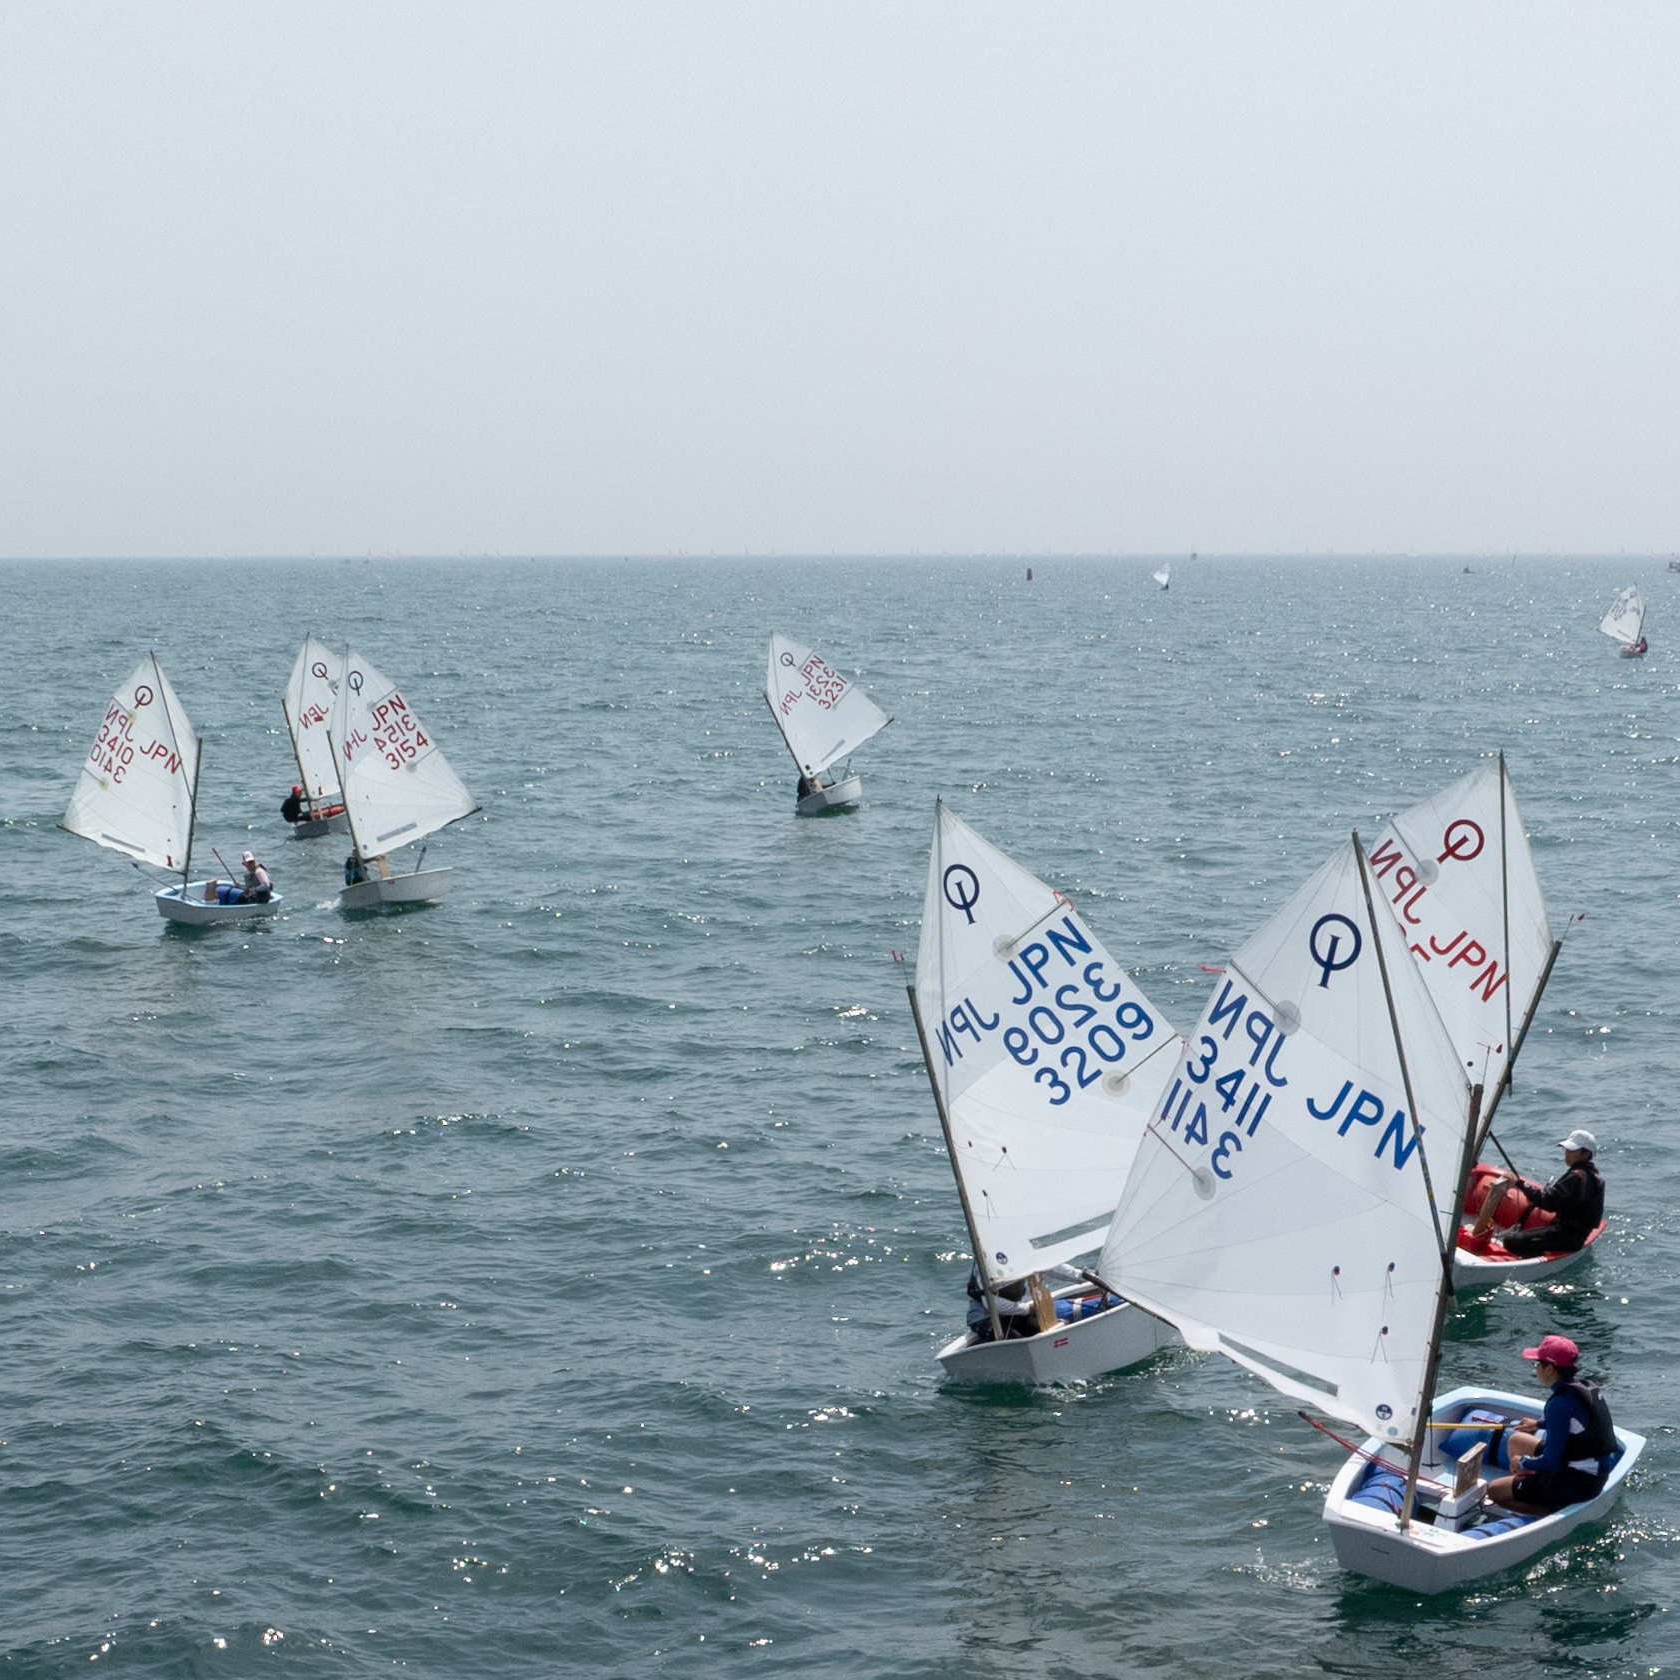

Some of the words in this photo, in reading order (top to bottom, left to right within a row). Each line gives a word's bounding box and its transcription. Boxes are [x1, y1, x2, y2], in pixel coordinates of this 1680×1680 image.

[801, 654, 825, 687] JPN
[371, 694, 406, 731] JPN
[818, 675, 848, 710] 3231
[98, 724, 134, 765] 3410
[140, 740, 182, 774] JPN
[385, 731, 429, 770] 3154
[1007, 916, 1093, 1005] JPN
[1429, 930, 1509, 1003] JPN
[1034, 1002, 1154, 1106] 3209
[1186, 1035, 1273, 1138] 3411
[1307, 1079, 1426, 1171] JPN
